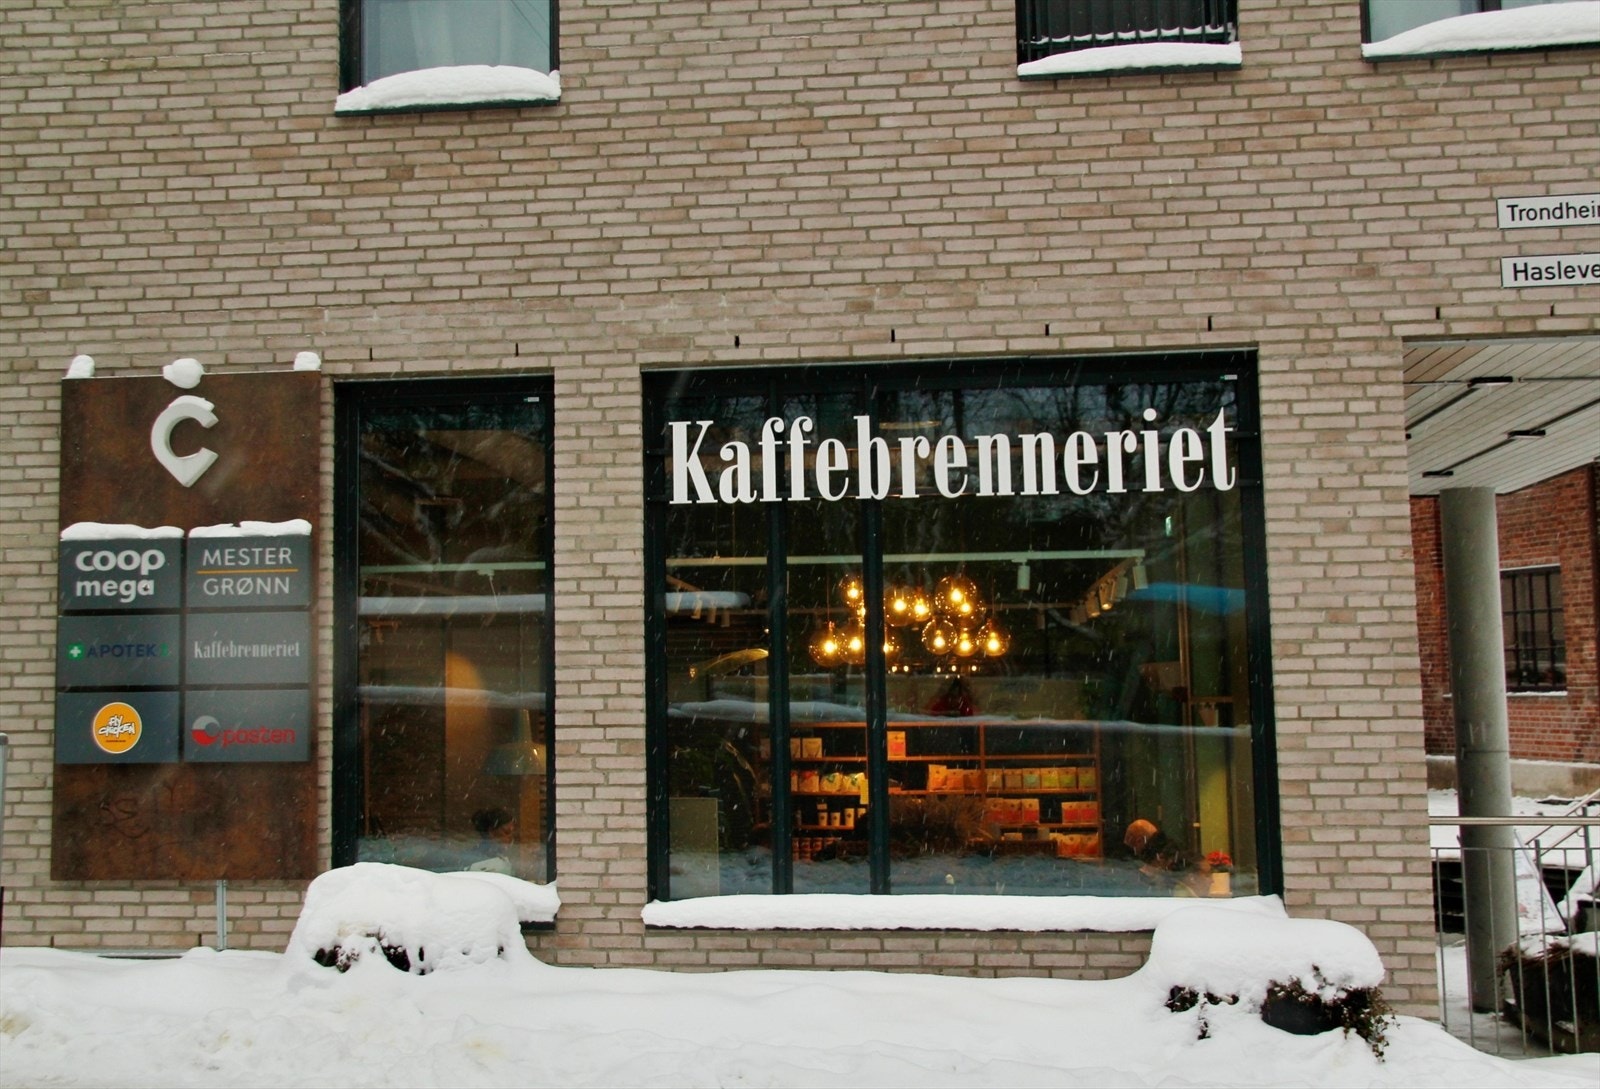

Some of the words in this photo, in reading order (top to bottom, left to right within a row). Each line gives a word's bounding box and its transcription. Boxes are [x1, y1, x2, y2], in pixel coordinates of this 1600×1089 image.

[1506, 200, 1600, 221] Trondhei
[1512, 261, 1600, 281] Hasleve
[669, 407, 1236, 504] Kaffebrenneriet
[75, 549, 165, 575] coop
[202, 547, 293, 566] MESTER
[76, 579, 154, 603] mega
[203, 577, 290, 596] GRØNN
[87, 644, 157, 658] APOTEK
[222, 726, 296, 748] posten
